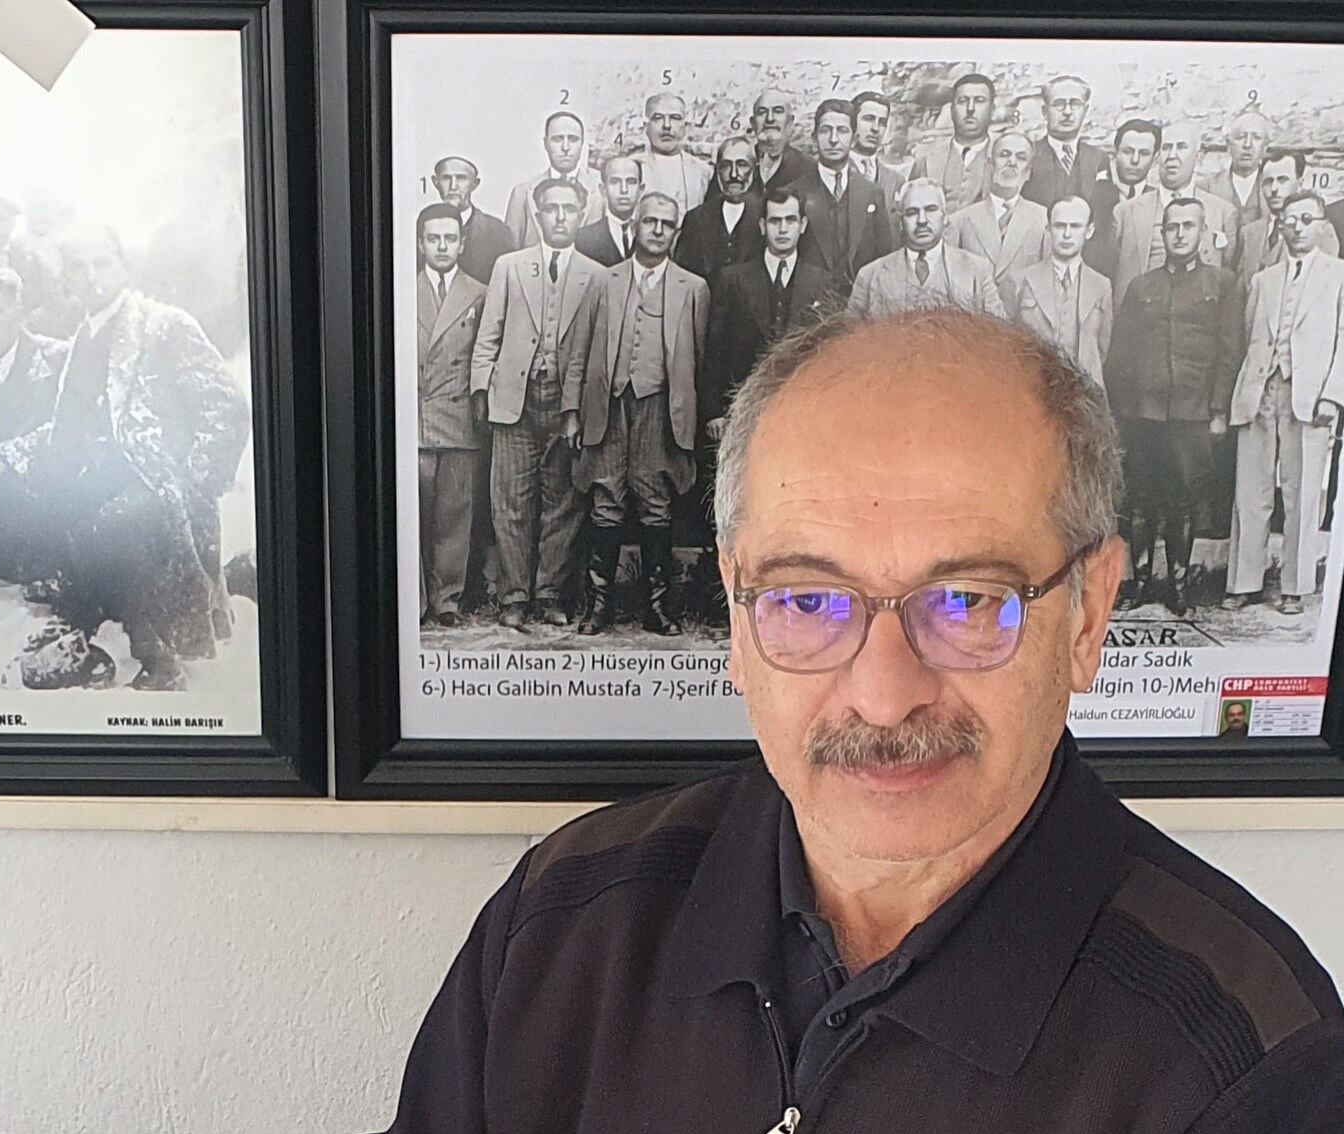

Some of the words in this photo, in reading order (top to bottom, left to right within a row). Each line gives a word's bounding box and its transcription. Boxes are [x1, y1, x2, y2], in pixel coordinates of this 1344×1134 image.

[662, 69, 672, 86] 5
[831, 75, 841, 91] 7
[559, 88, 570, 106] 2
[730, 115, 741, 131] 6
[612, 132, 624, 147] 4
[419, 176, 427, 195] 1
[1310, 172, 1331, 190] 10
[530, 261, 540, 279] 3
[418, 653, 441, 672] 1-)
[446, 650, 500, 671] İsmail
[506, 654, 556, 671] Alsan
[561, 653, 586, 672] 2-)
[591, 653, 665, 675] Hüseyin
[1103, 651, 1139, 668] ldar
[1143, 650, 1193, 668] Sadık
[422, 680, 446, 698] 6-)
[451, 680, 491, 697] Hacı
[497, 679, 562, 697] Galibin
[567, 679, 641, 697] Mustafa
[652, 679, 718, 701] 7-)Şerif
[1141, 676, 1219, 696] 10-)Meh
[1223, 679, 1254, 691] CHP
[1068, 708, 1107, 720] Haldun
[1110, 706, 1196, 720] CEZAYİRLİOĞLU
[107, 717, 149, 728] KAYNAK:
